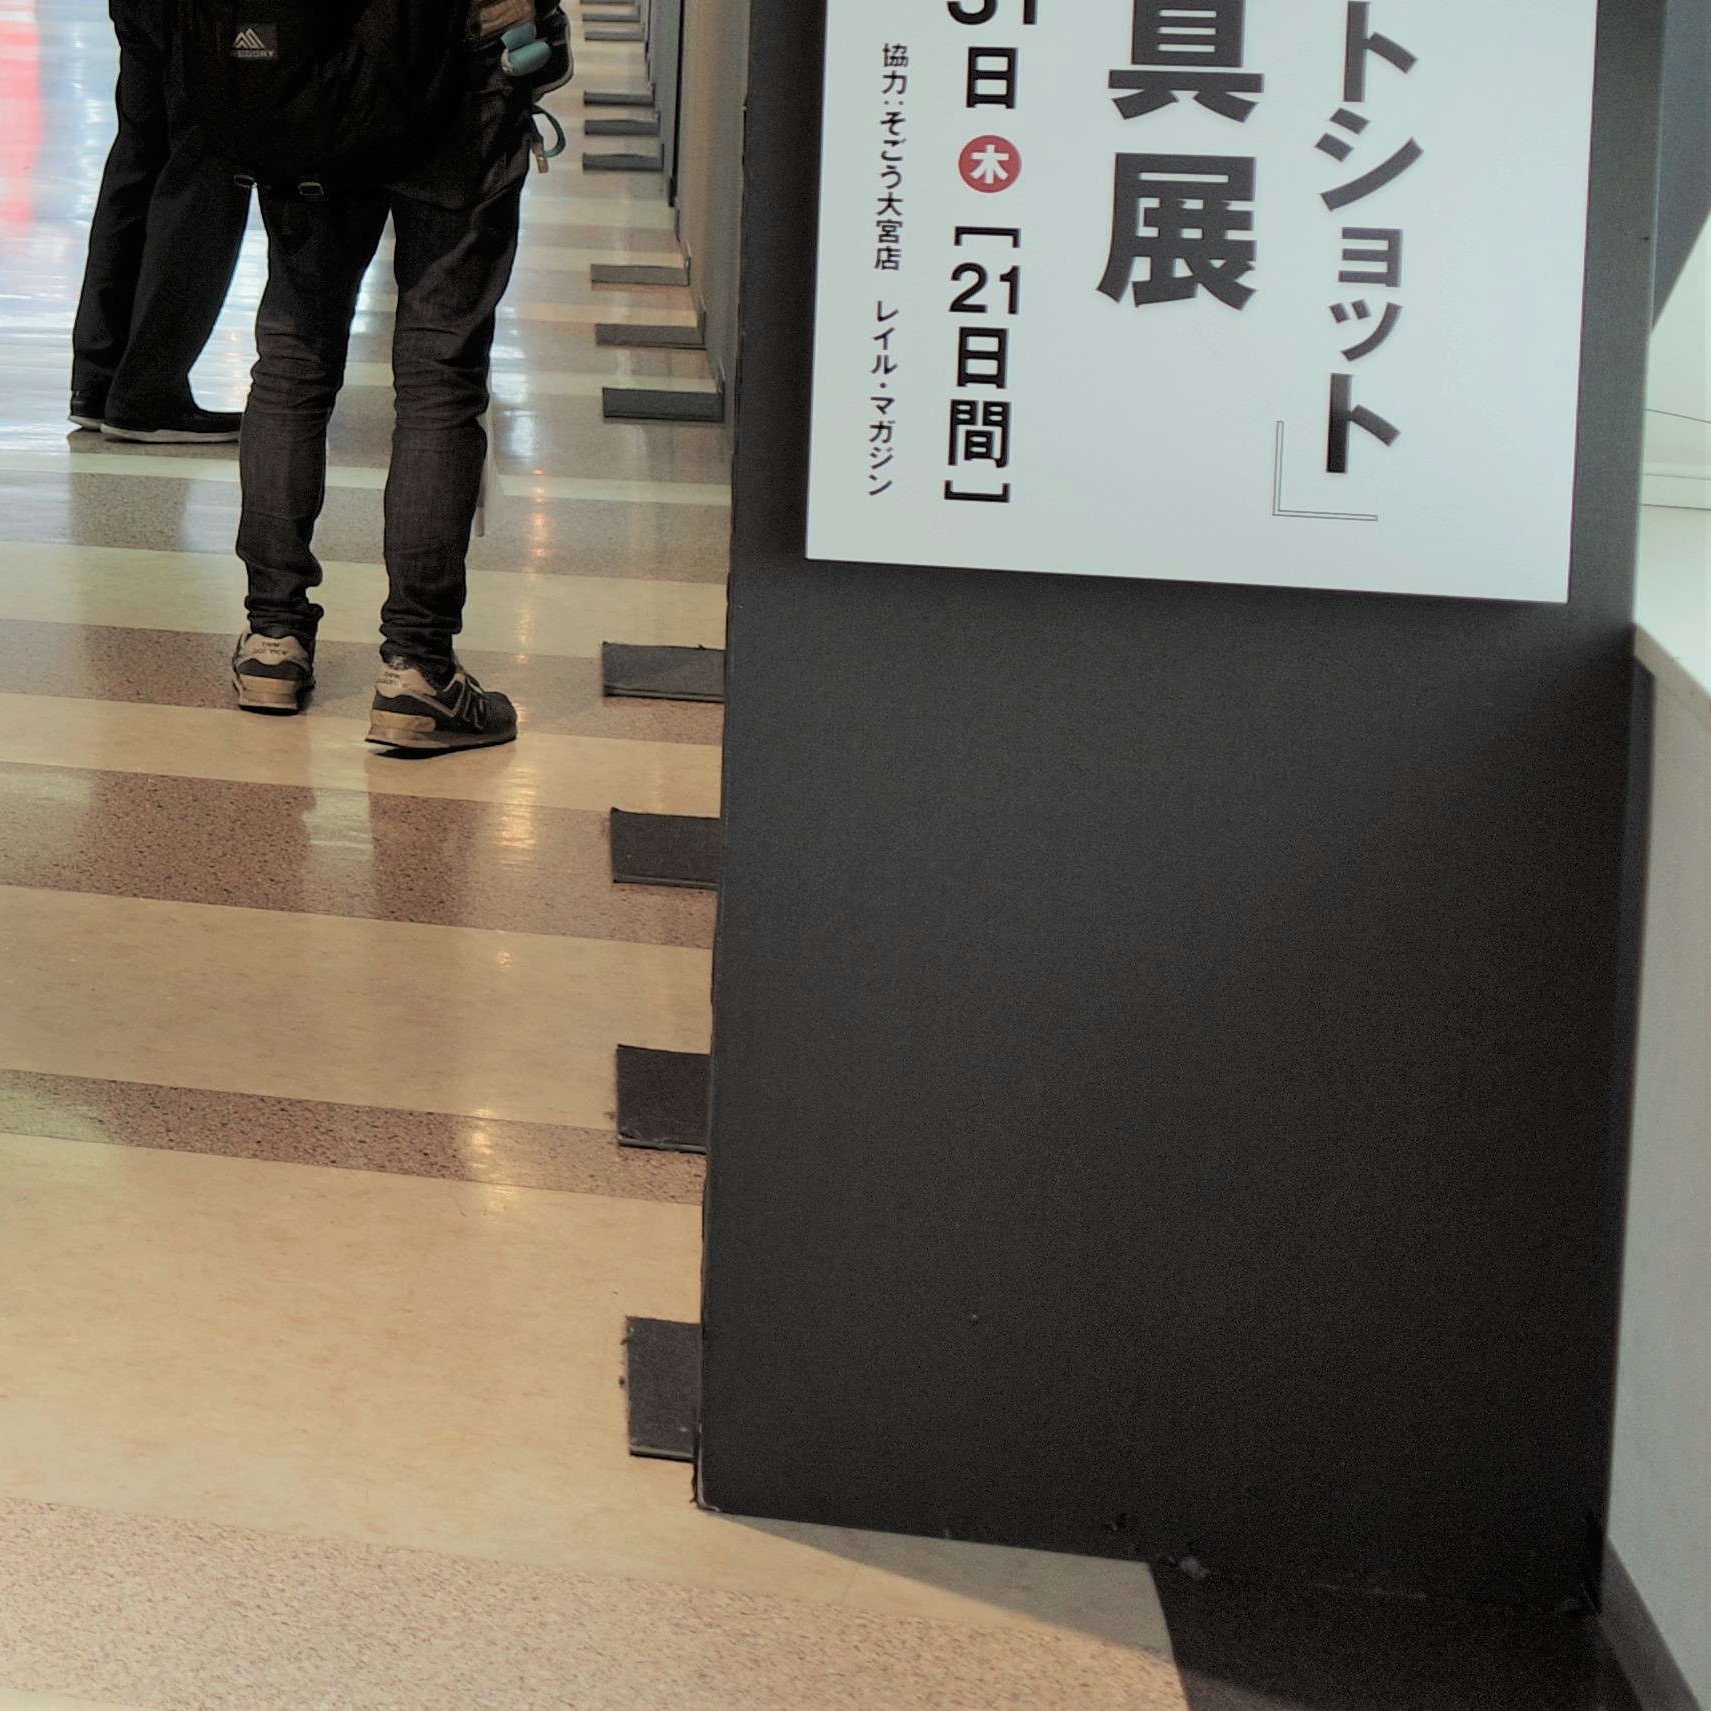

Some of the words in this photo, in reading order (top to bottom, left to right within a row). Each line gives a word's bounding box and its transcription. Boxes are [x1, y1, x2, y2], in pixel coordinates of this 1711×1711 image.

[875, 44, 908, 270] 協力：そごう大宮店
[869, 301, 898, 495] レイル・マガジン
